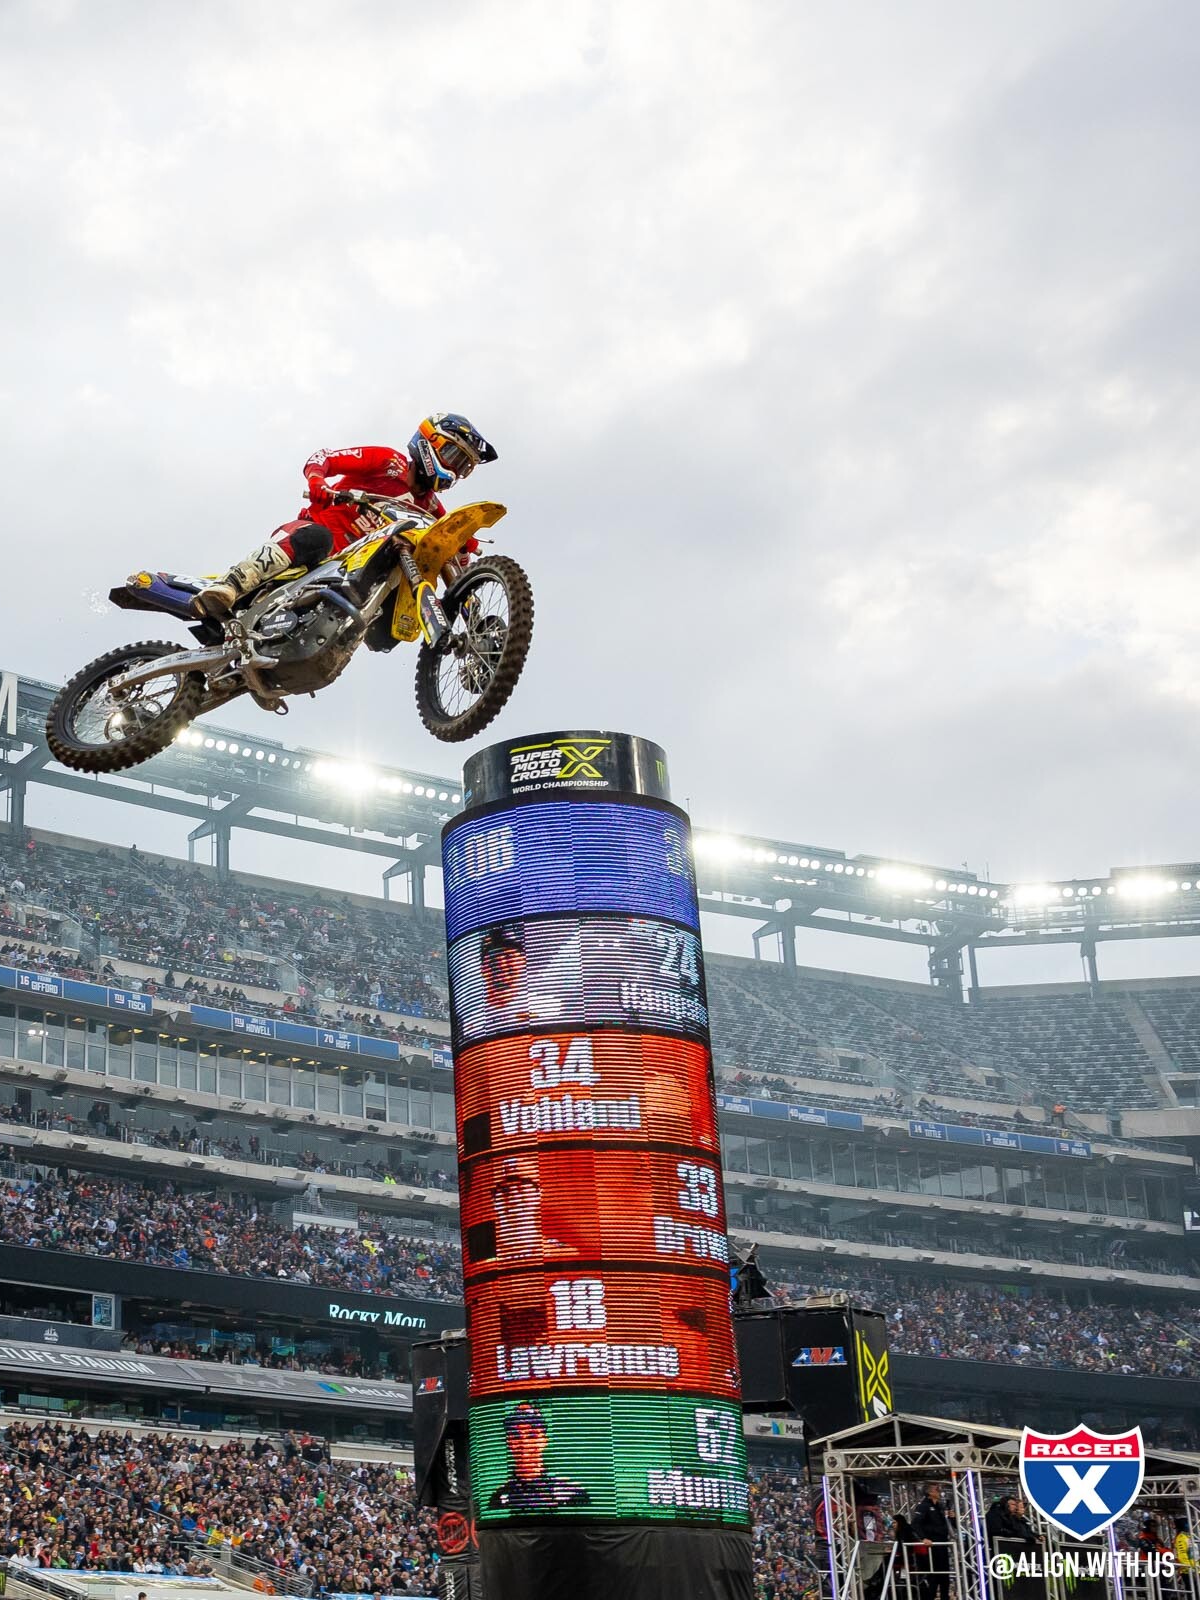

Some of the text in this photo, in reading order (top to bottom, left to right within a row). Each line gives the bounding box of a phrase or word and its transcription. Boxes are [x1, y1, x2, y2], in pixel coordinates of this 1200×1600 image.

[427, 595, 447, 627] DUNLOP
[510, 750, 563, 765] SUPER
[514, 759, 561, 773] MOTO
[510, 767, 562, 783] CROSS
[512, 780, 609, 795] WORLD CHAMPIONSHIP
[20, 975, 30, 986] 16
[31, 980, 58, 994] GIFFORD
[127, 999, 146, 1012] TISCH
[245, 1023, 272, 1036] HOWELL
[324, 1033, 334, 1044] 70
[335, 1039, 351, 1050] HUFF
[529, 1037, 601, 1089] 34
[500, 1093, 642, 1136] Vohland
[677, 1161, 719, 1219] 33
[549, 1278, 607, 1330] 18
[497, 1343, 679, 1381] Lawrence
[792, 1346, 848, 1366] AMA
[59, 1353, 156, 1375] STADIUM
[344, 1385, 408, 1400] MetLife
